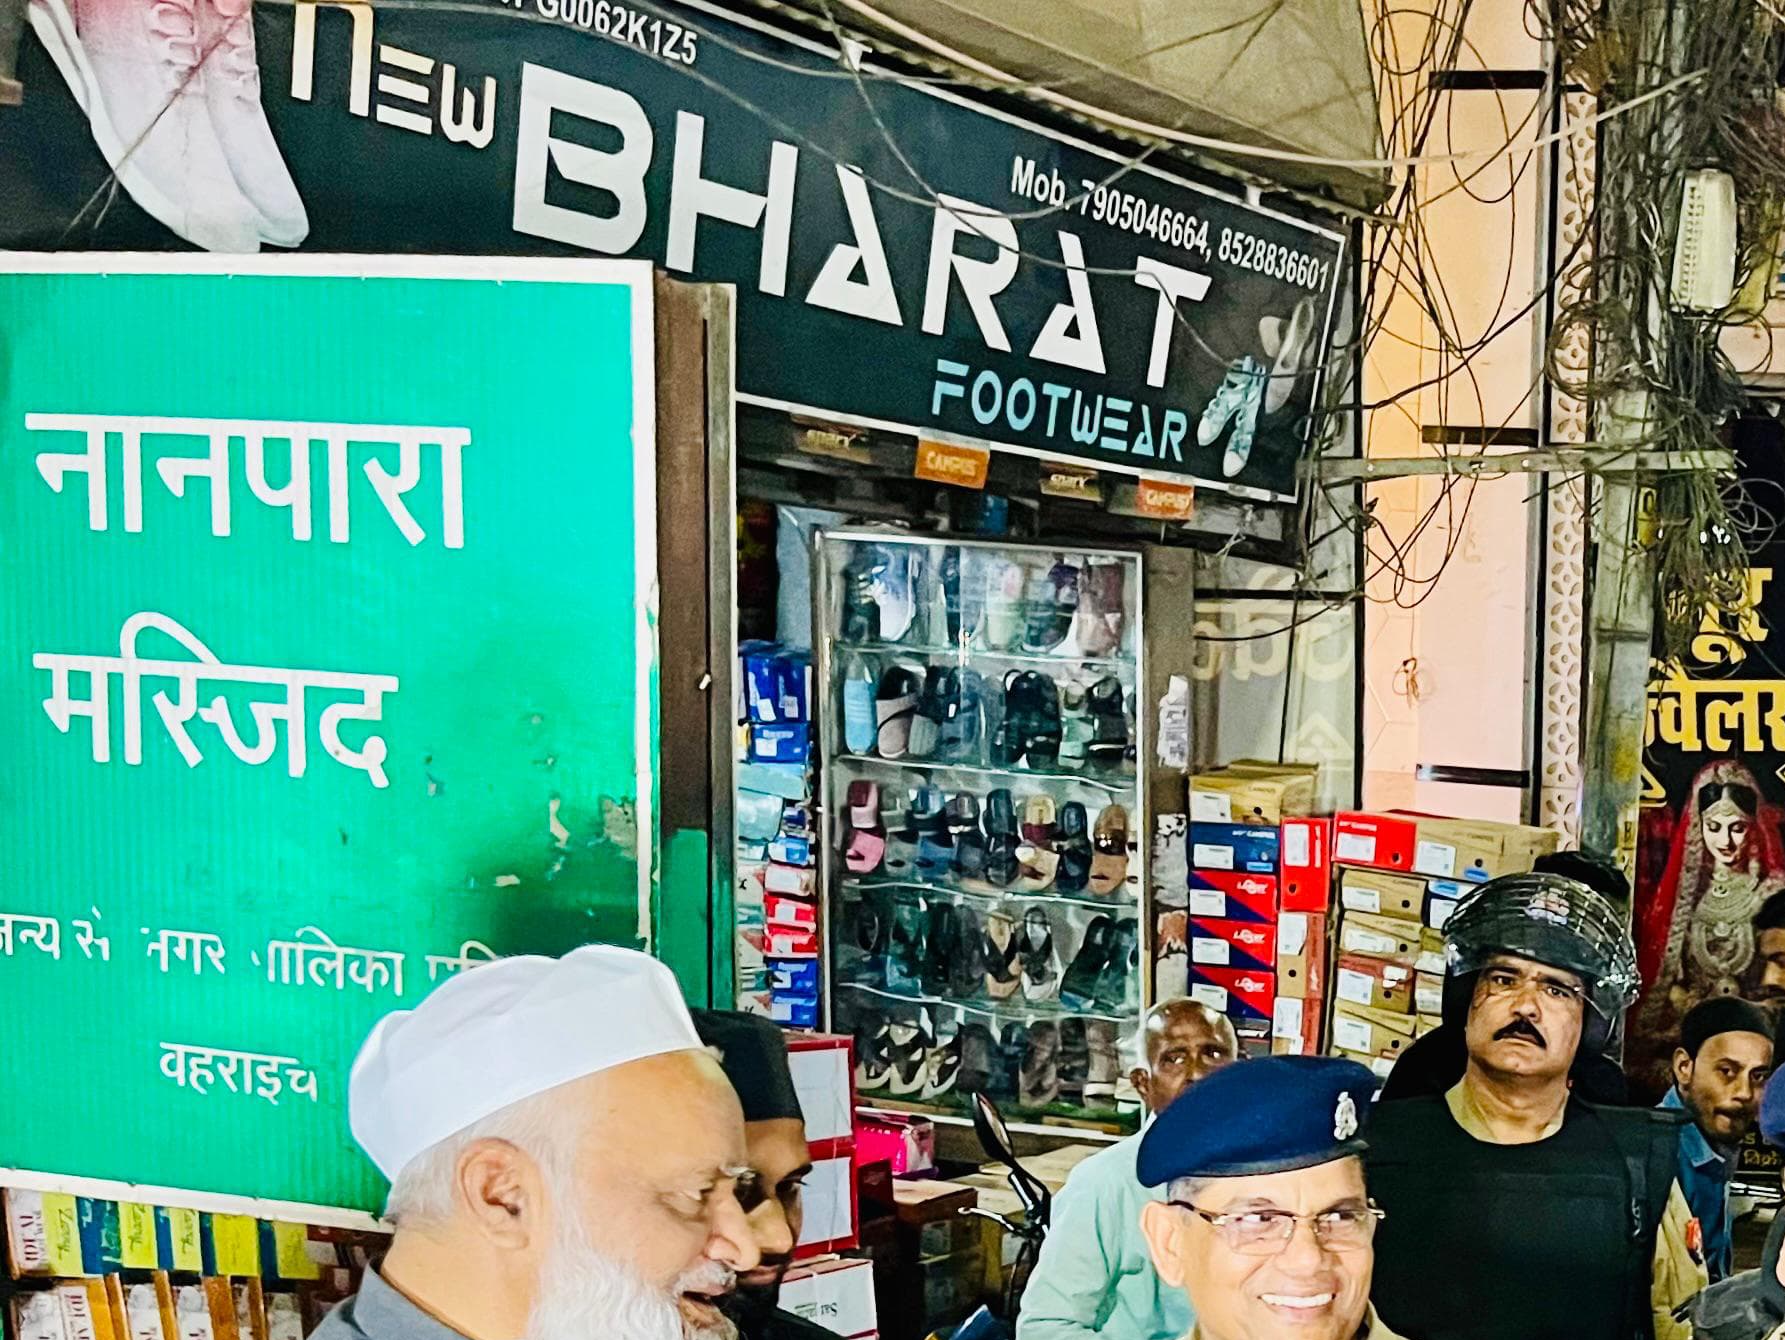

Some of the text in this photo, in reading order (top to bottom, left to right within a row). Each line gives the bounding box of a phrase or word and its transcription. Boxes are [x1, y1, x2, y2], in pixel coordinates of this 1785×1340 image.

[512, 61, 1211, 388] BHARAT
[1011, 156, 1330, 293] Mob. 7905046664, 8528836601
[932, 359, 1187, 462] FOOTWEAR
[25, 413, 471, 549] नानपारा
[33, 611, 399, 789] मस्जिद
